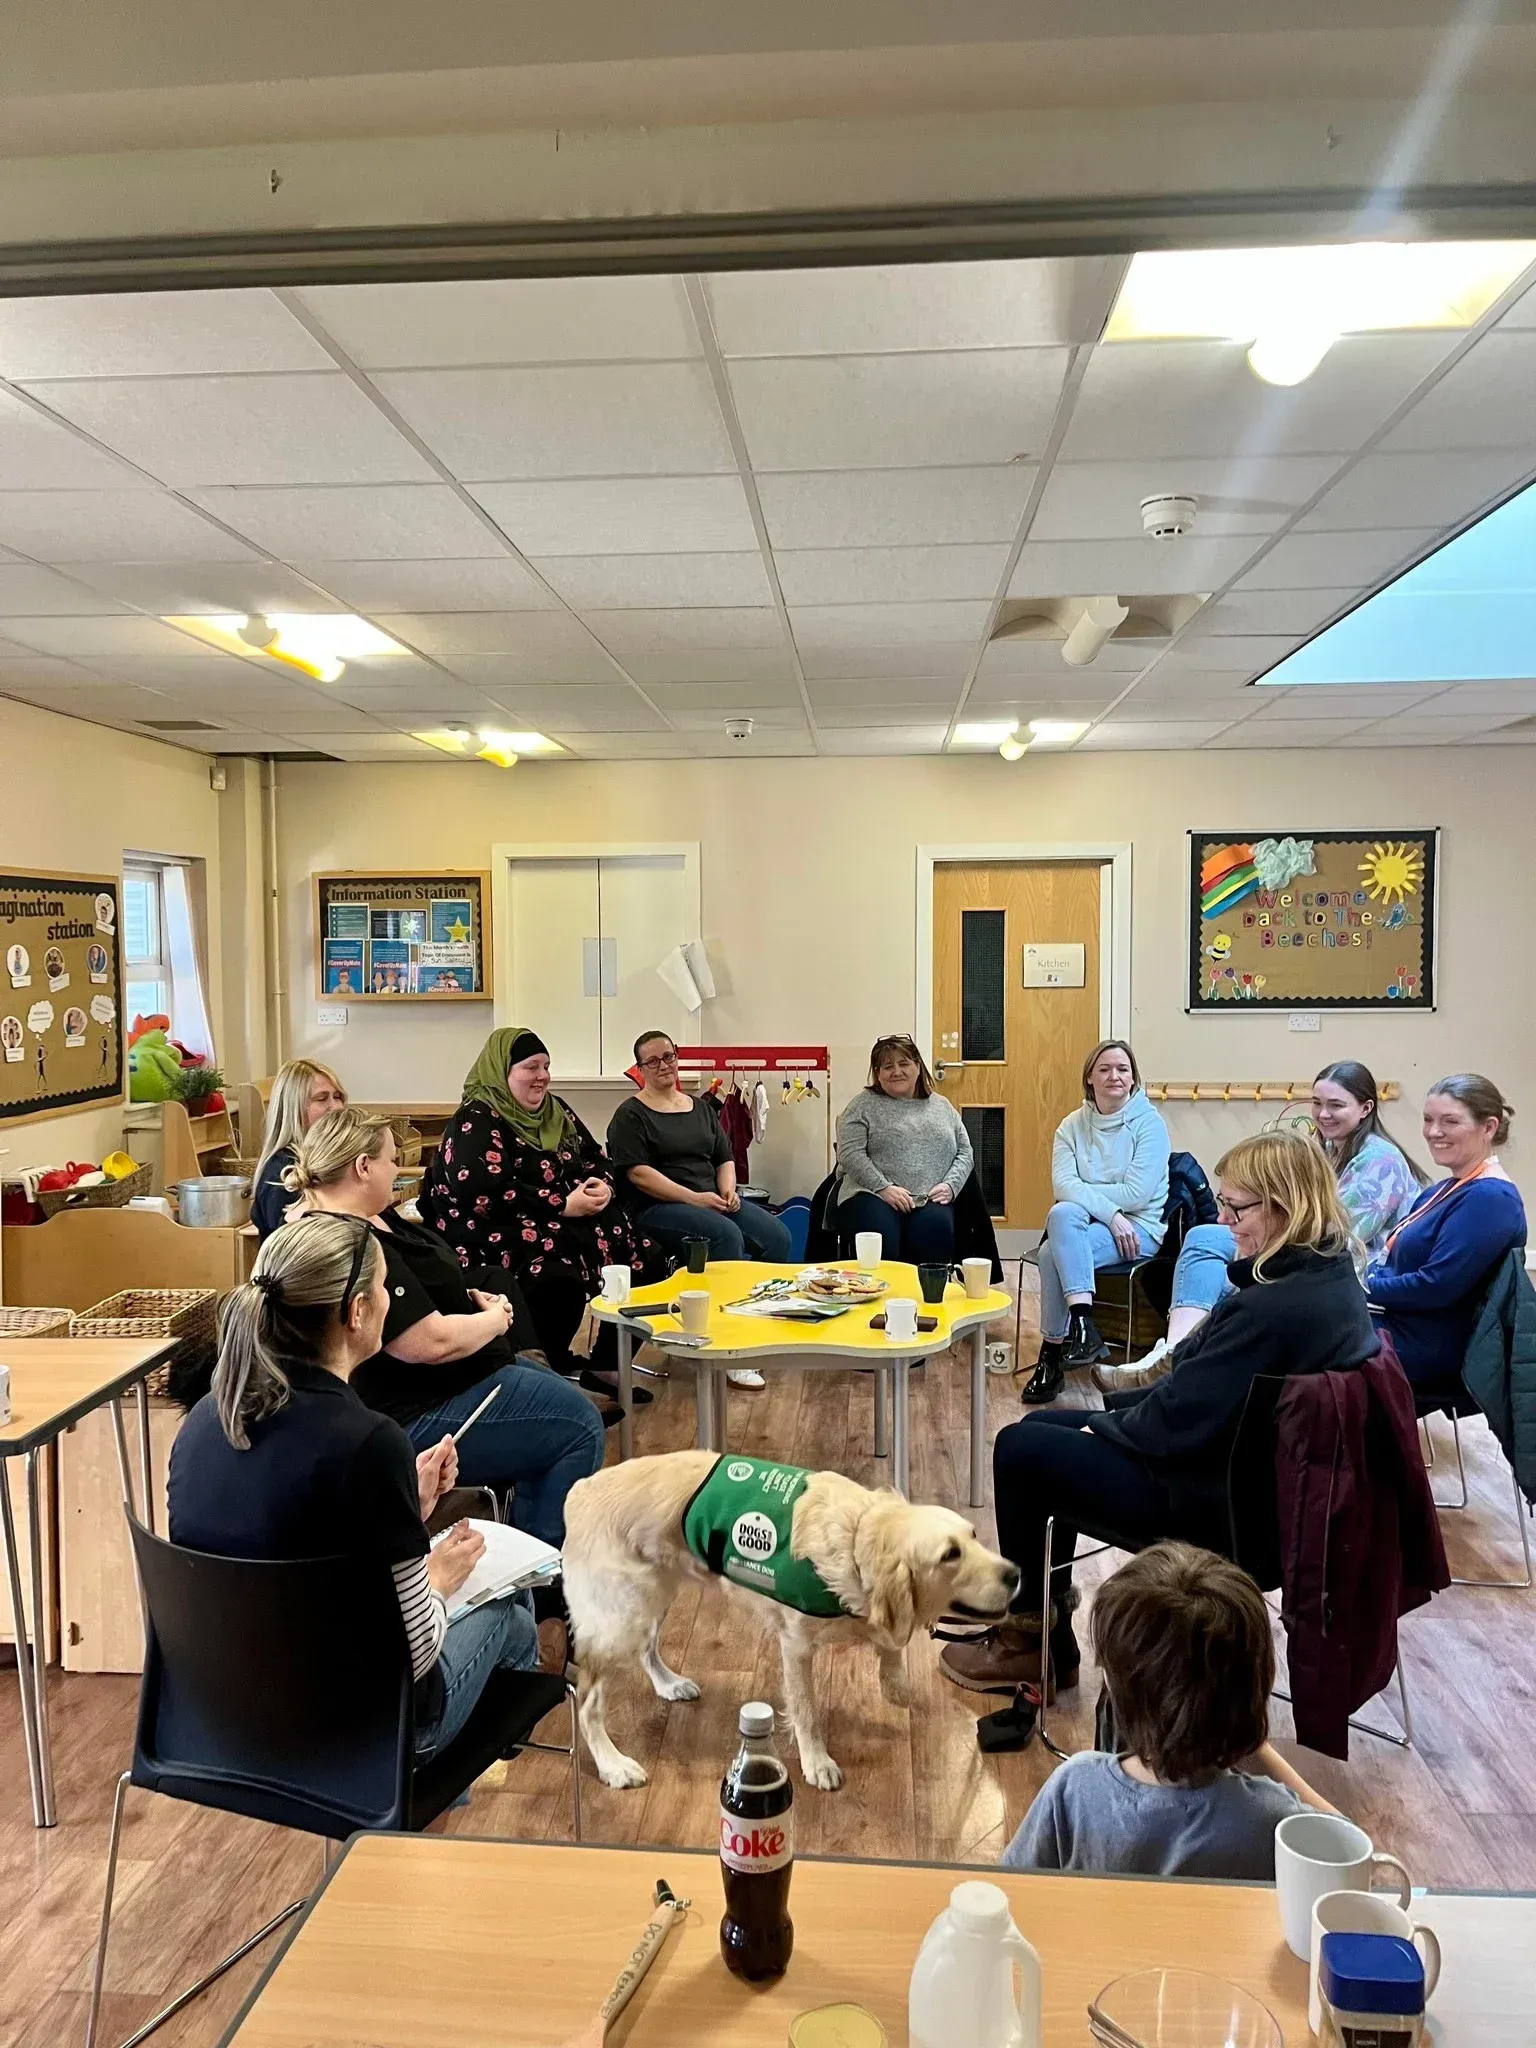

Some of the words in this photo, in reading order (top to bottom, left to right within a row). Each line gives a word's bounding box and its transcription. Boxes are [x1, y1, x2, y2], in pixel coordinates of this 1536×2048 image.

[331, 888, 412, 900] Information
[414, 886, 466, 900] Station
[1255, 889, 1367, 908] Welcome
[1304, 909, 1327, 926] to
[1333, 907, 1373, 927] The
[47, 918, 95, 940] station
[1261, 928, 1372, 950] Beeches!
[1037, 958, 1070, 968] Kitchen
[739, 1523, 768, 1540] DOGS
[738, 1535, 771, 1552] GOOD
[721, 1817, 785, 1858] Coke
